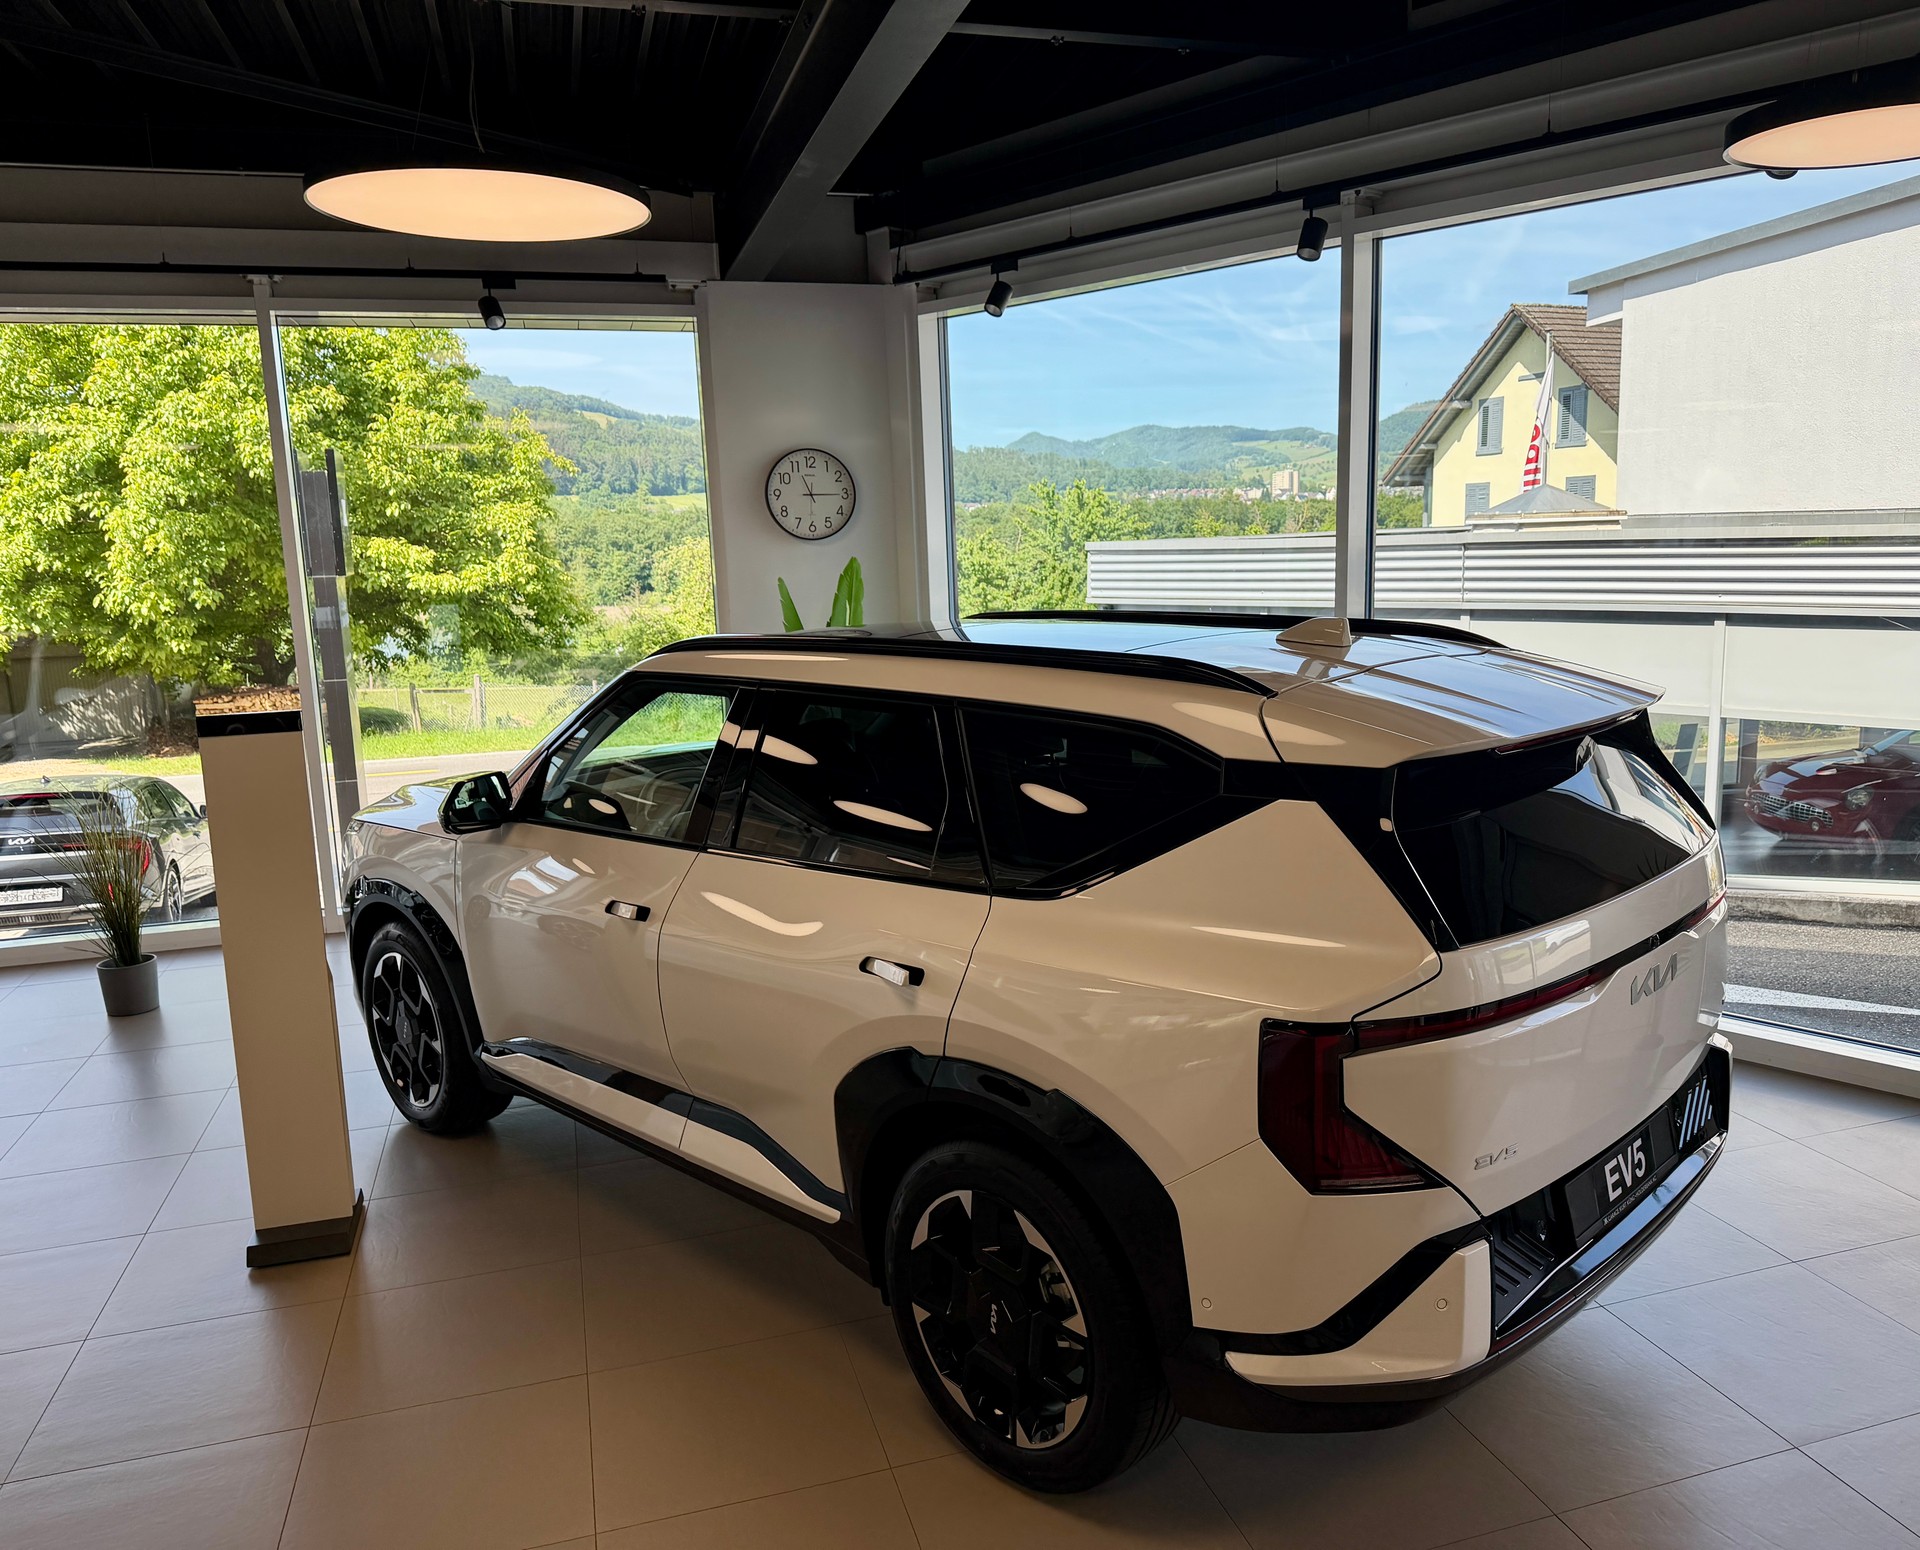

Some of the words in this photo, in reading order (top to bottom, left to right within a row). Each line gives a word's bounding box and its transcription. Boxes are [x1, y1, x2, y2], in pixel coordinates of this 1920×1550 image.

[790, 461, 799, 472] 11
[804, 456, 816, 468] 12
[824, 461, 829, 472] 1
[778, 473, 791, 484] 10
[834, 471, 842, 482] 2
[773, 489, 781, 500] 9
[841, 488, 849, 500] 3
[781, 506, 788, 517] 8
[836, 505, 843, 516] 4
[795, 517, 802, 529] 7
[809, 521, 816, 532] 6
[824, 517, 832, 528] 5
[1630, 952, 1678, 1006] KIA
[1473, 1142, 1519, 1171] EV5
[1604, 1137, 1646, 1202] EV5
